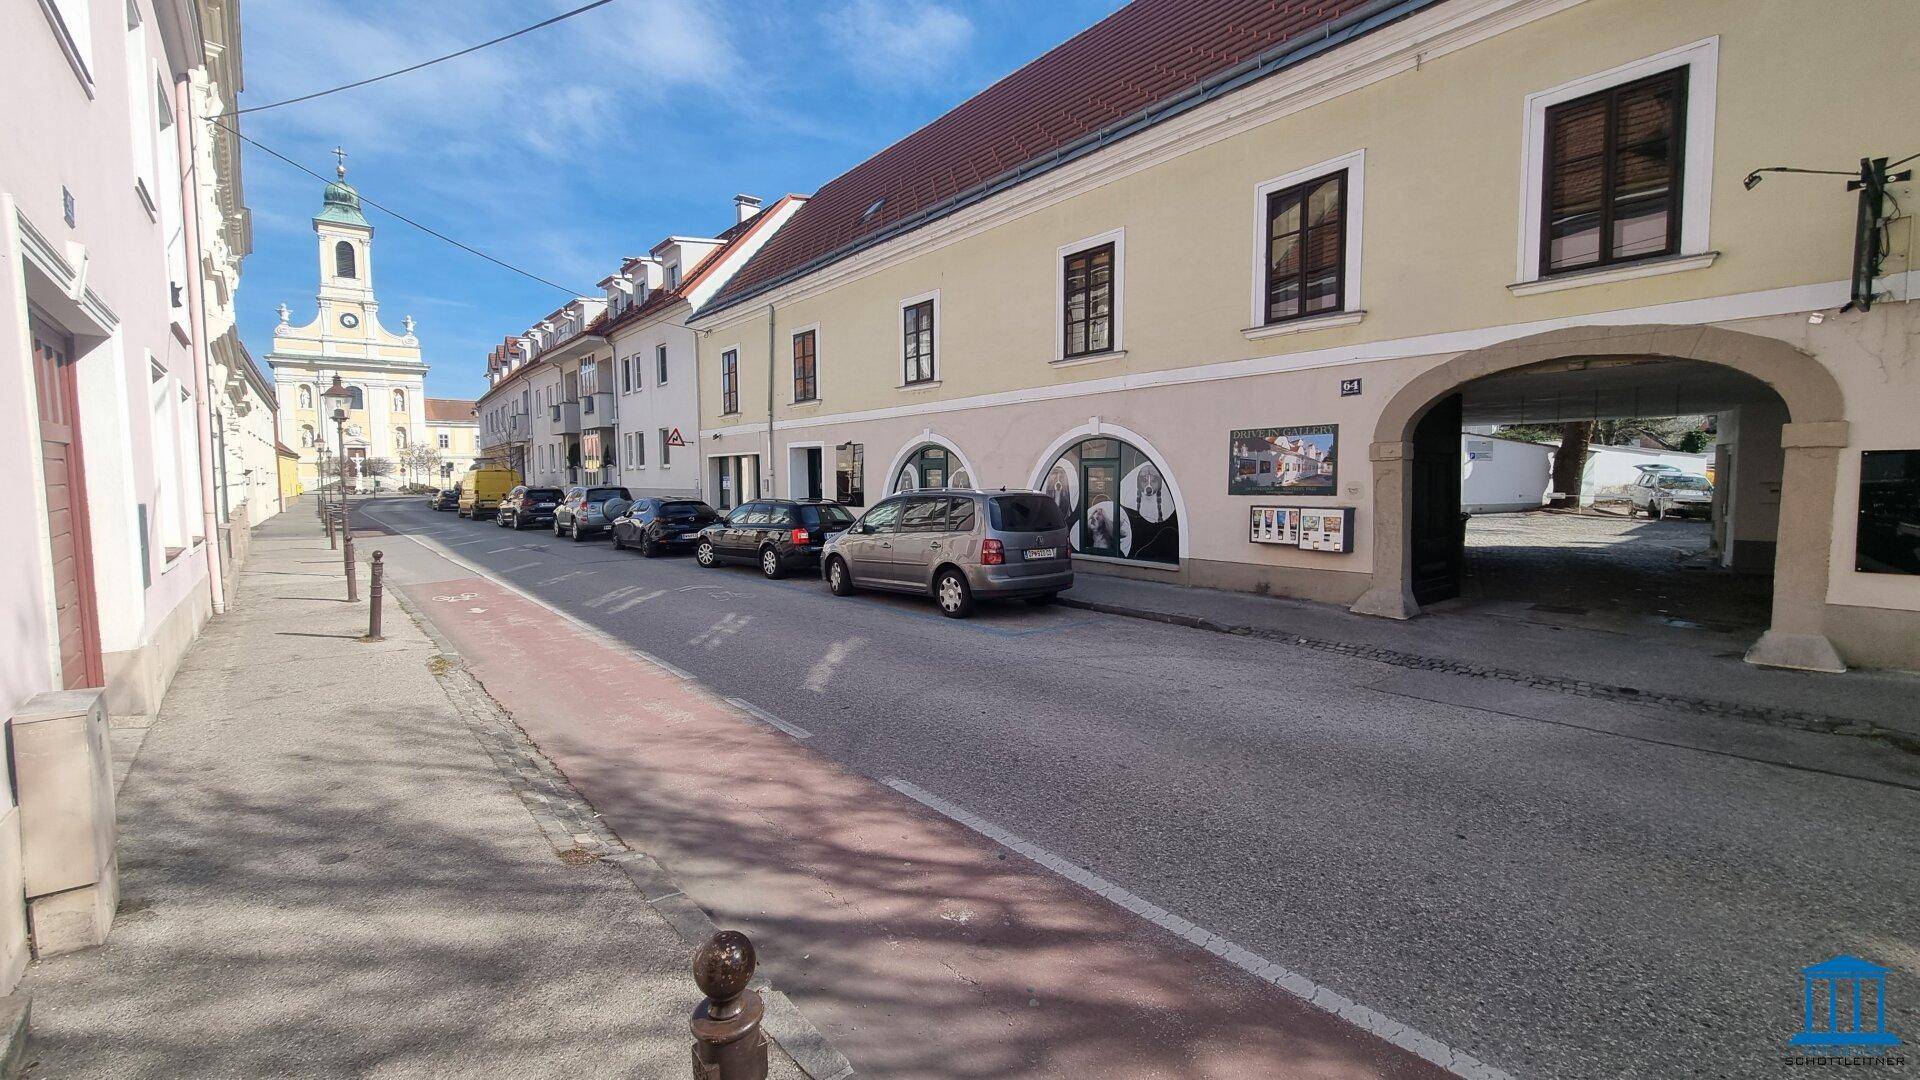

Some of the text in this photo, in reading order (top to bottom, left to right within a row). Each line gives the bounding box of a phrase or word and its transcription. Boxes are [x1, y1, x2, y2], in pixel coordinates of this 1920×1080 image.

[1343, 380, 1359, 390] 64
[1233, 425, 1335, 439] DRIVE IN GALLERY
